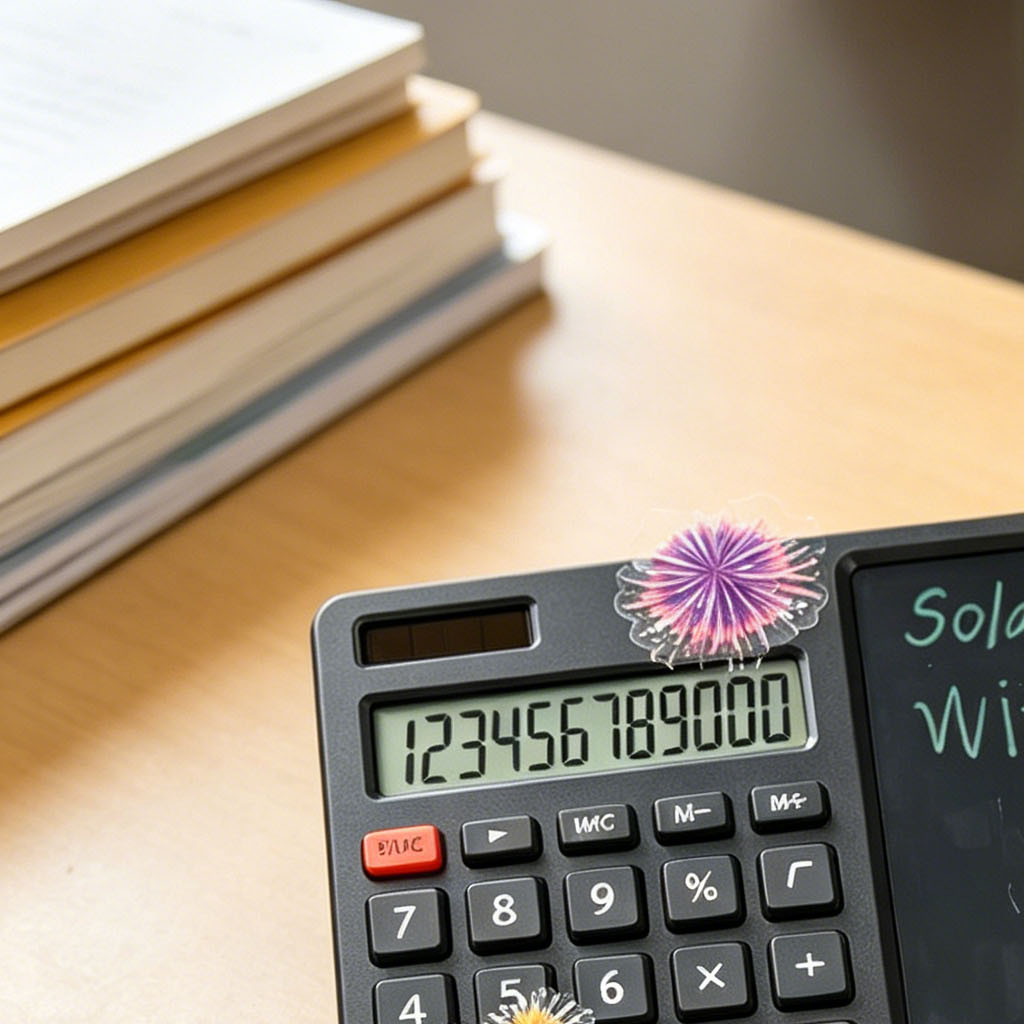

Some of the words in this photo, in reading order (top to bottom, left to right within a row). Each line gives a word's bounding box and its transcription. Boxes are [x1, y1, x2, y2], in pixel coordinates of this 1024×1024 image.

[404, 672, 792, 786] 123456789000
[590, 881, 615, 916] 9
[684, 870, 718, 904] %
[392, 904, 417, 940] 7
[491, 893, 518, 927] 8
[500, 978, 529, 1011] 5
[599, 969, 625, 1005] 6
